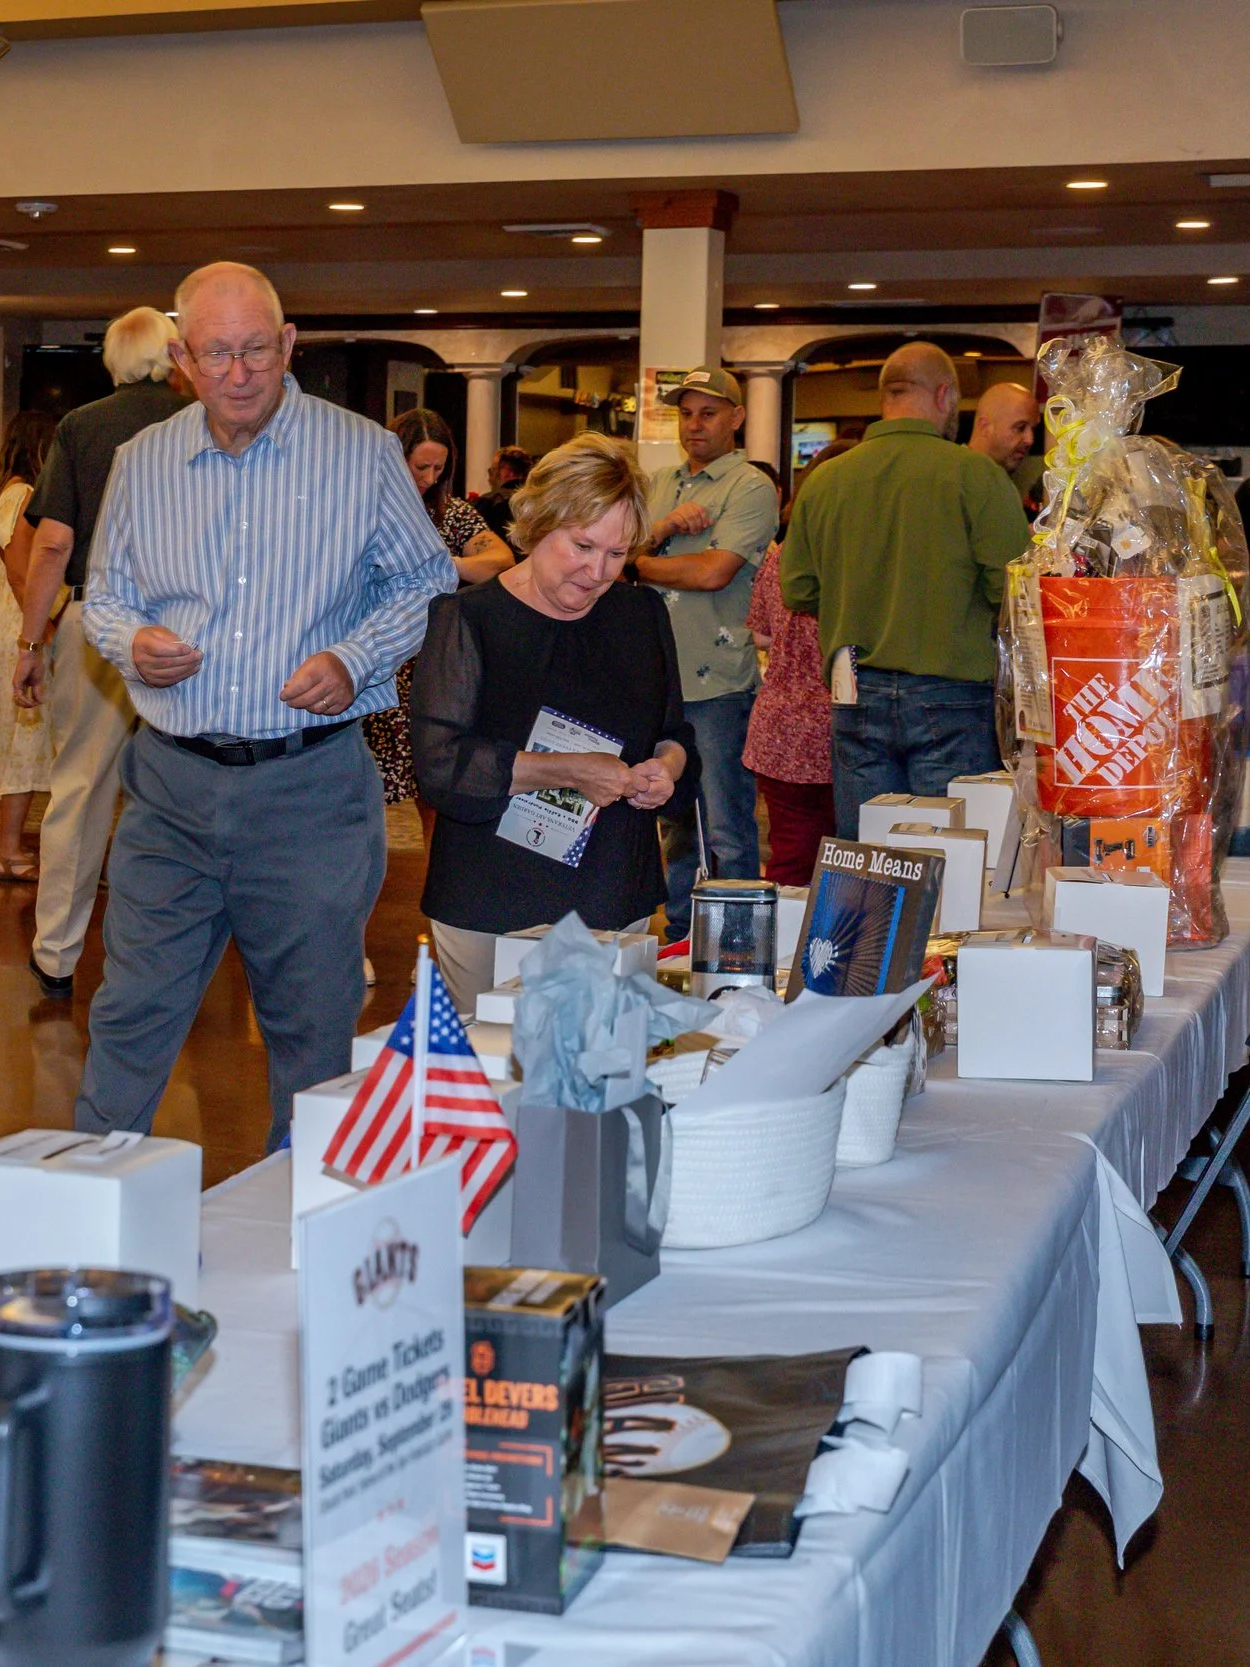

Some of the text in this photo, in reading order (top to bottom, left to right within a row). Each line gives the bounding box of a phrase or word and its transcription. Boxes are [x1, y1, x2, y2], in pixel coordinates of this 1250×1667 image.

[1056, 667, 1177, 786] HOME
[1062, 672, 1116, 722] THE
[821, 843, 923, 881] Home Means
[353, 1237, 420, 1305] GIANTS
[328, 1376, 338, 1406] 2
[342, 1358, 389, 1398] Game
[392, 1329, 445, 1371] Tickets
[484, 1379, 559, 1412] DEVERS
[321, 1363, 450, 1450] Giants vs Dodgers
